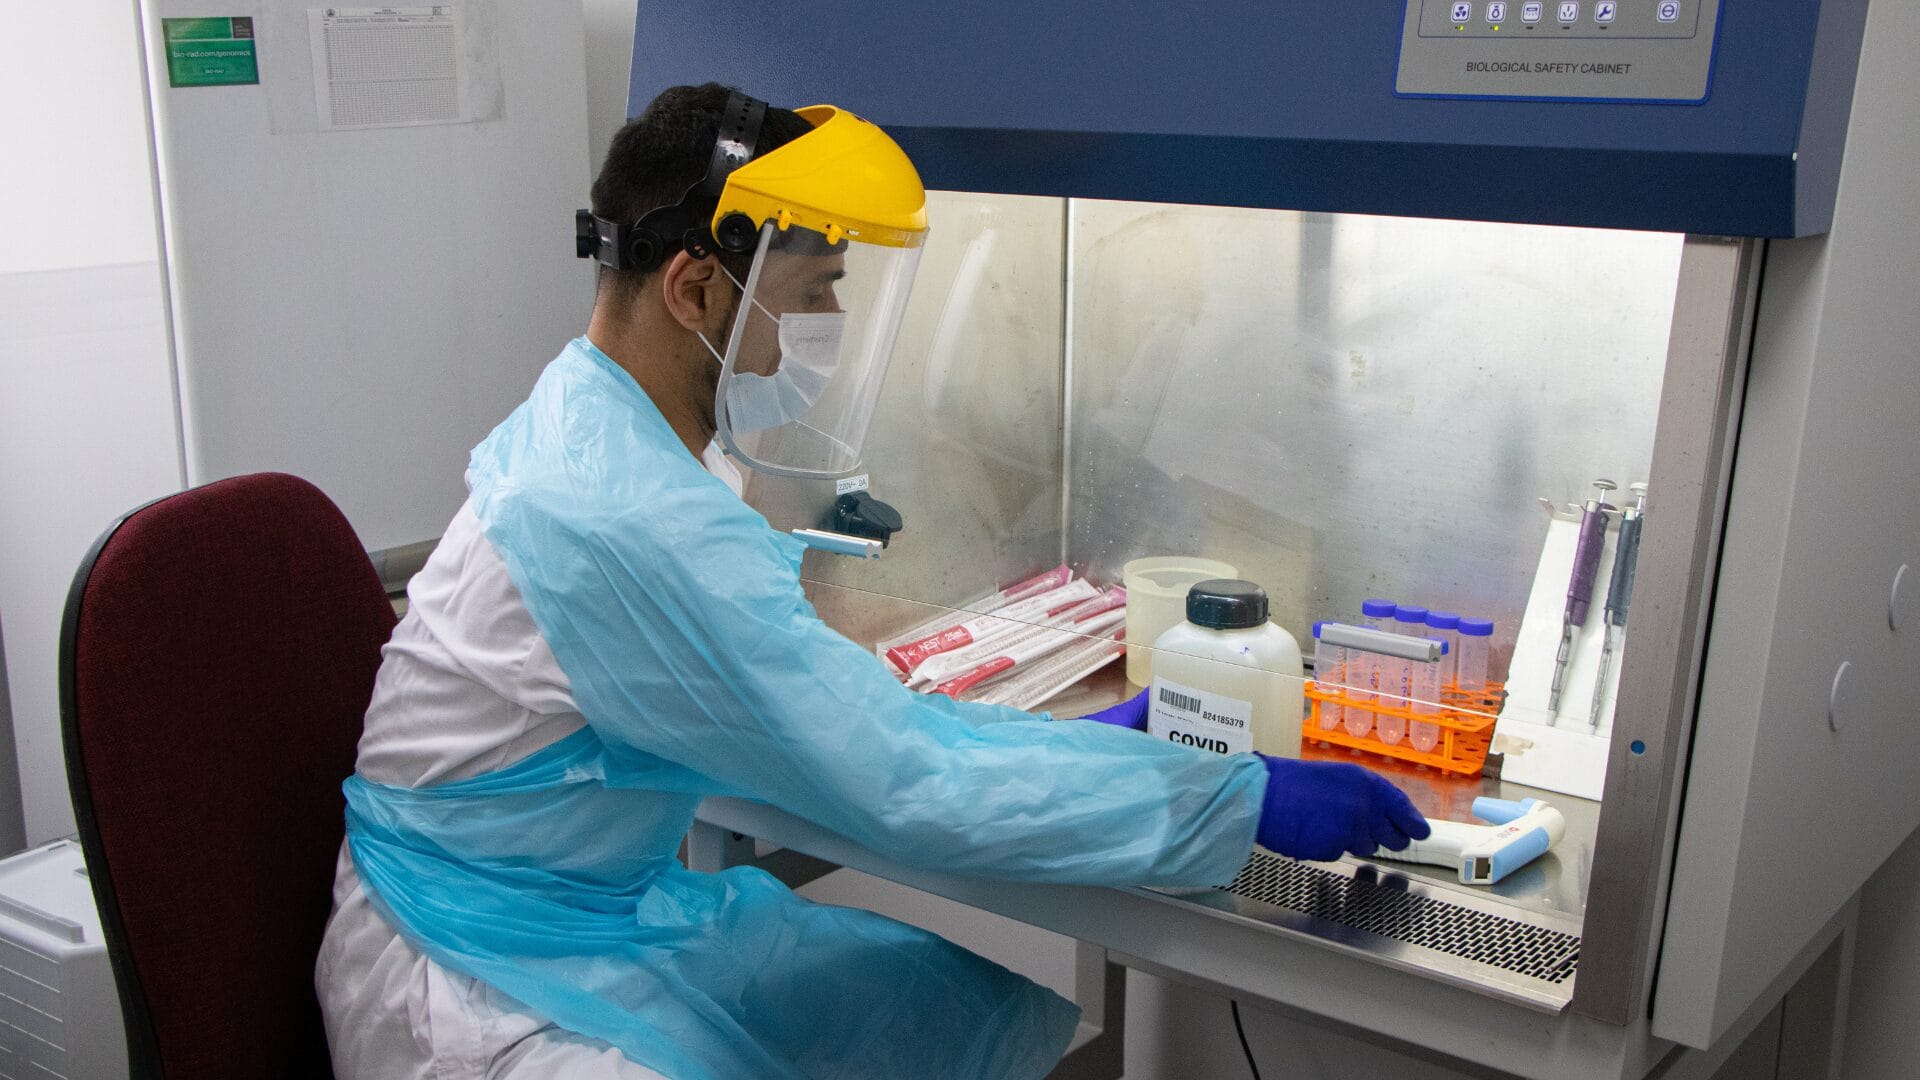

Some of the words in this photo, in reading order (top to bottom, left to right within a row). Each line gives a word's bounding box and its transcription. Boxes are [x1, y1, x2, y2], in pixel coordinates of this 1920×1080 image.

[1466, 61, 1531, 72] BIOLOGICAL
[1534, 62, 1578, 73] SAFETY
[1580, 63, 1632, 74] CABINET
[920, 637, 941, 652] NEST
[1202, 711, 1244, 728] 824185379
[1168, 730, 1229, 755] COVID
